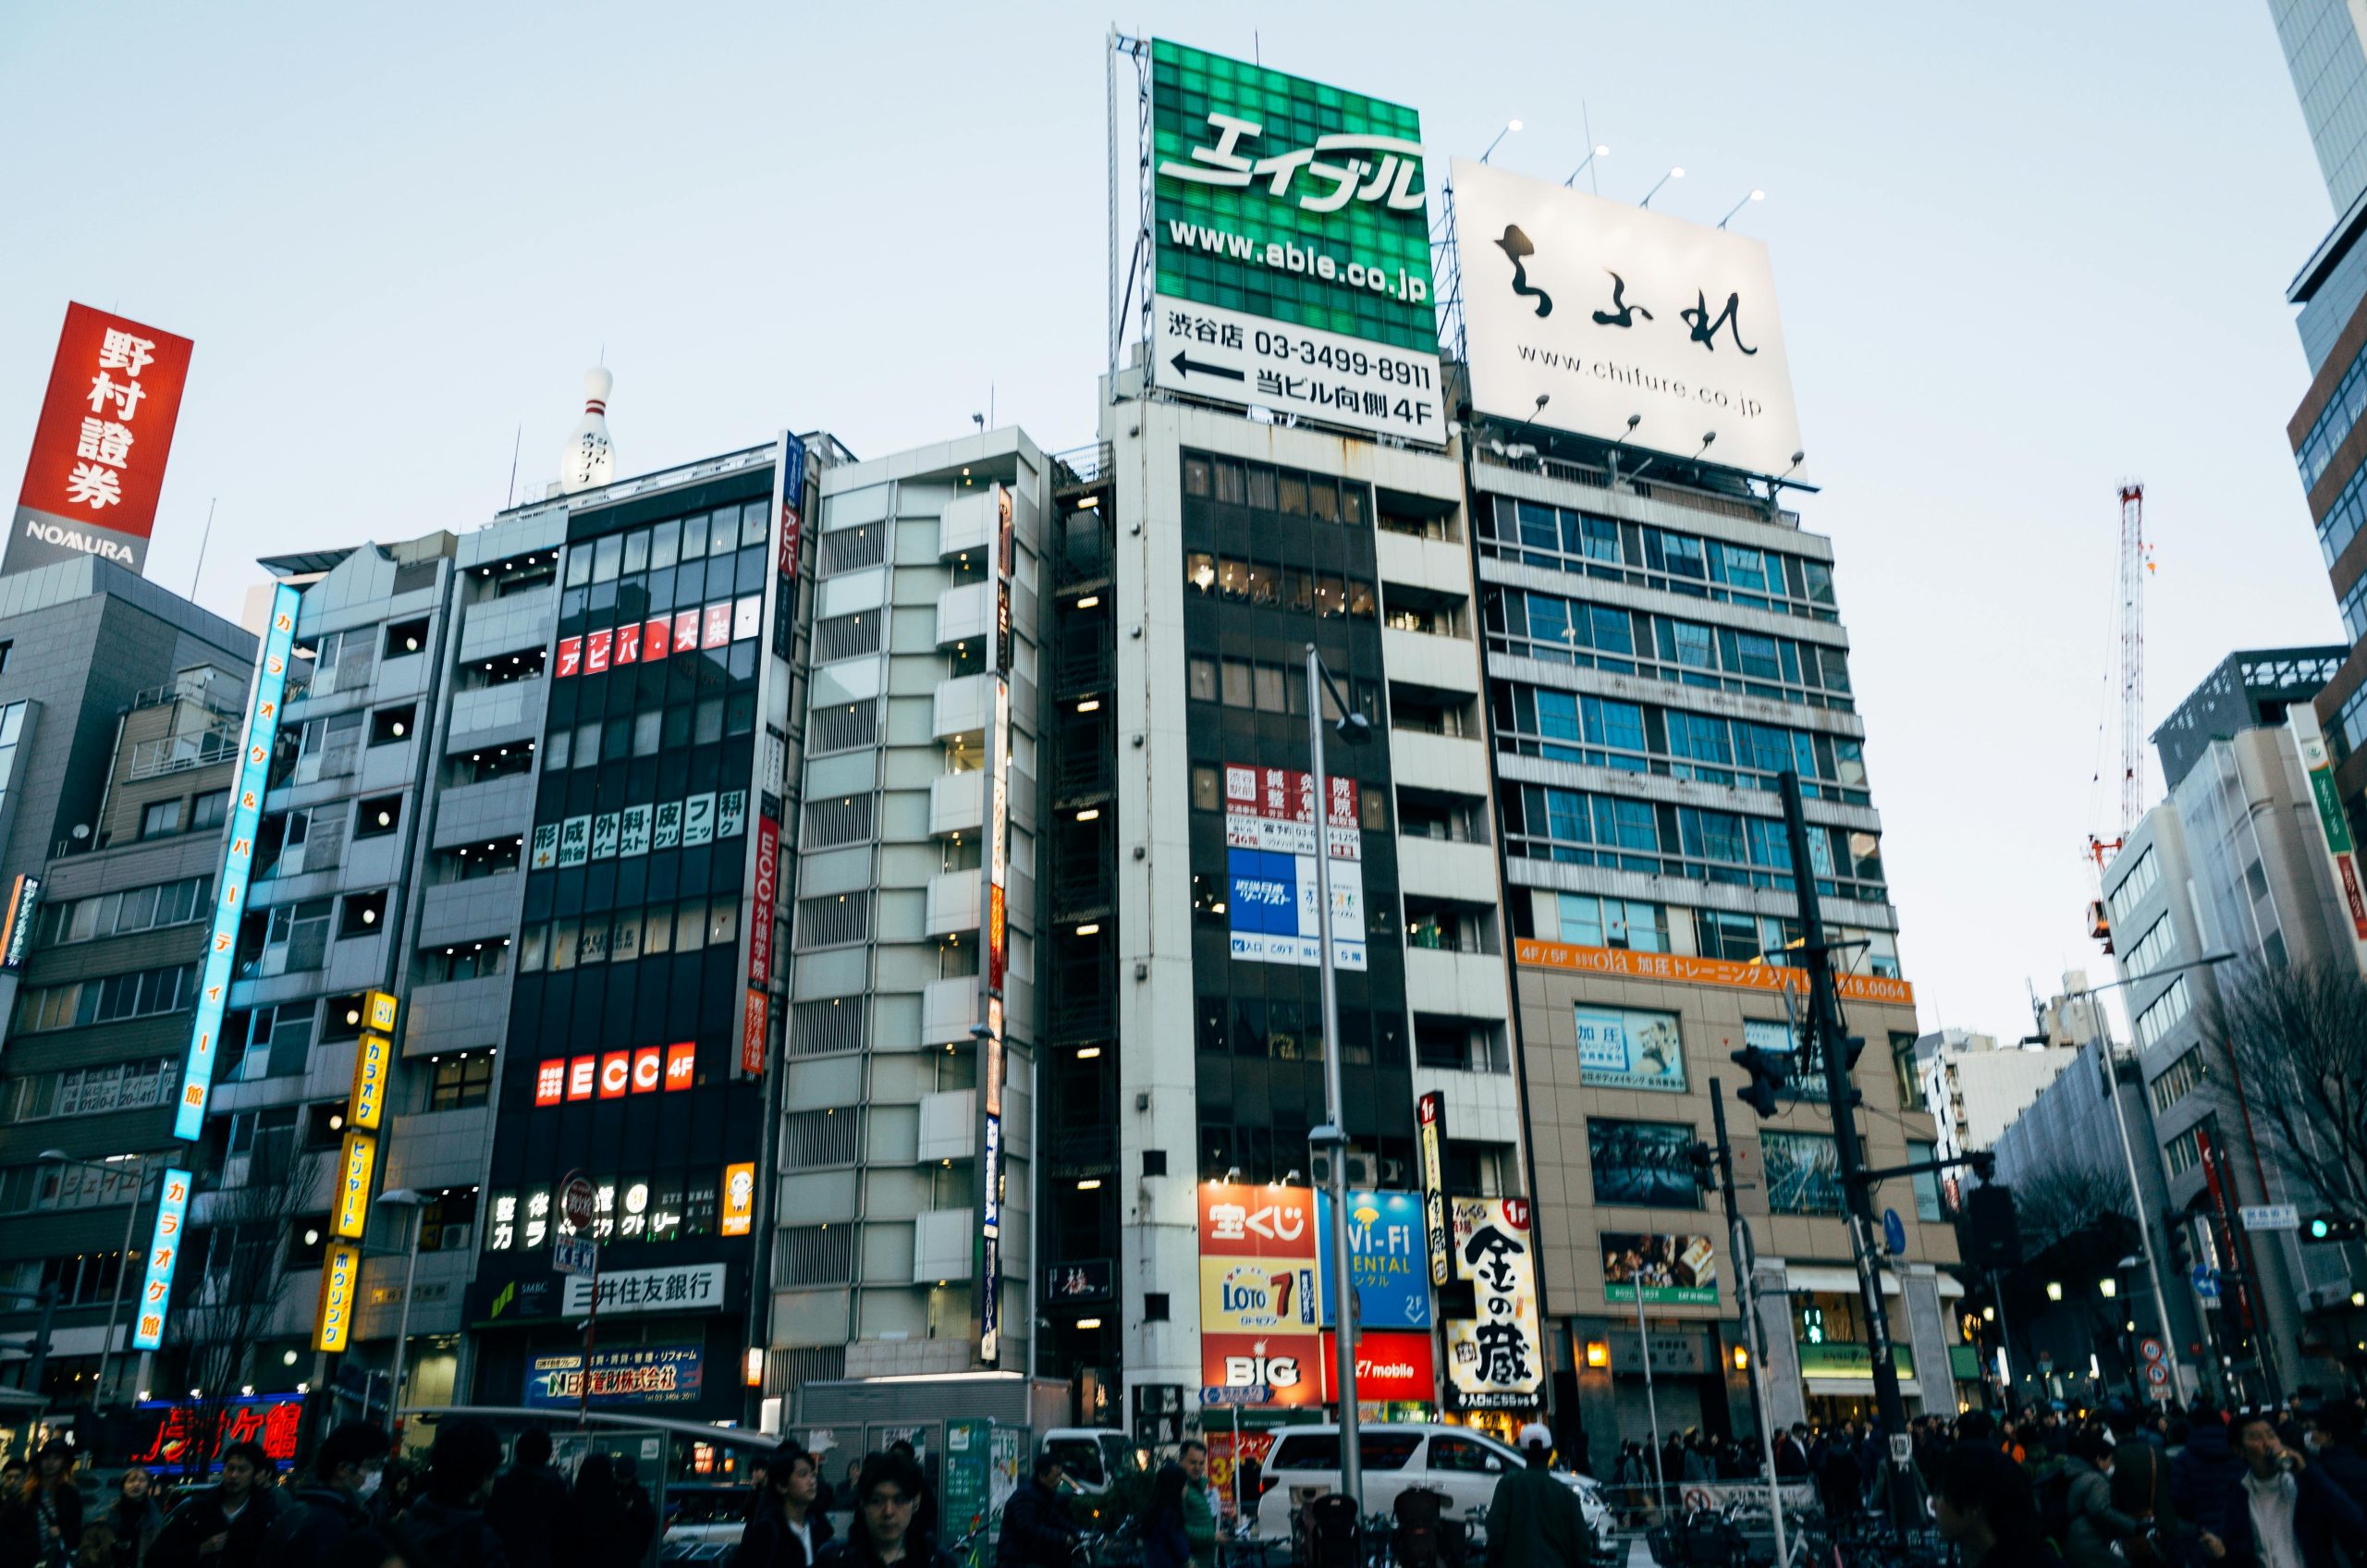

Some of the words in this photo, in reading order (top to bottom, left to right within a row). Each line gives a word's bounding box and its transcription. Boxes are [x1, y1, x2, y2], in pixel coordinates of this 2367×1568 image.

[1158, 111, 1426, 213] エイブル
[1169, 218, 1427, 304] www.able.co.jp
[1169, 311, 1244, 350] 渋谷店
[1255, 329, 1430, 390] 03-3499-8911
[1517, 342, 1762, 419] www.chifure.co.jp
[66, 326, 156, 509] 野村證券
[26, 520, 134, 565] NOMURA
[534, 792, 743, 850] 形成外科・皮フ科
[1522, 946, 1539, 962] 4F
[1551, 948, 1568, 963] 5F
[1637, 955, 1760, 986] 加圧トレーニング
[360, 1044, 380, 1119] カラオケ
[570, 1054, 660, 1096] ECC
[668, 1056, 694, 1078] 4F
[1208, 1203, 1305, 1241] 宝くじ
[1506, 1199, 1527, 1224] 1F
[140, 1182, 185, 1338] カラオケ館
[1353, 1256, 1411, 1273] ENTAL
[1354, 1274, 1390, 1288] ンタル
[572, 1272, 712, 1308] 三井住友銀行
[1222, 1282, 1267, 1313] LOTO
[1405, 1295, 1423, 1311] 2F
[1465, 1225, 1533, 1385] 金の蔵
[1225, 1355, 1300, 1387] BIG
